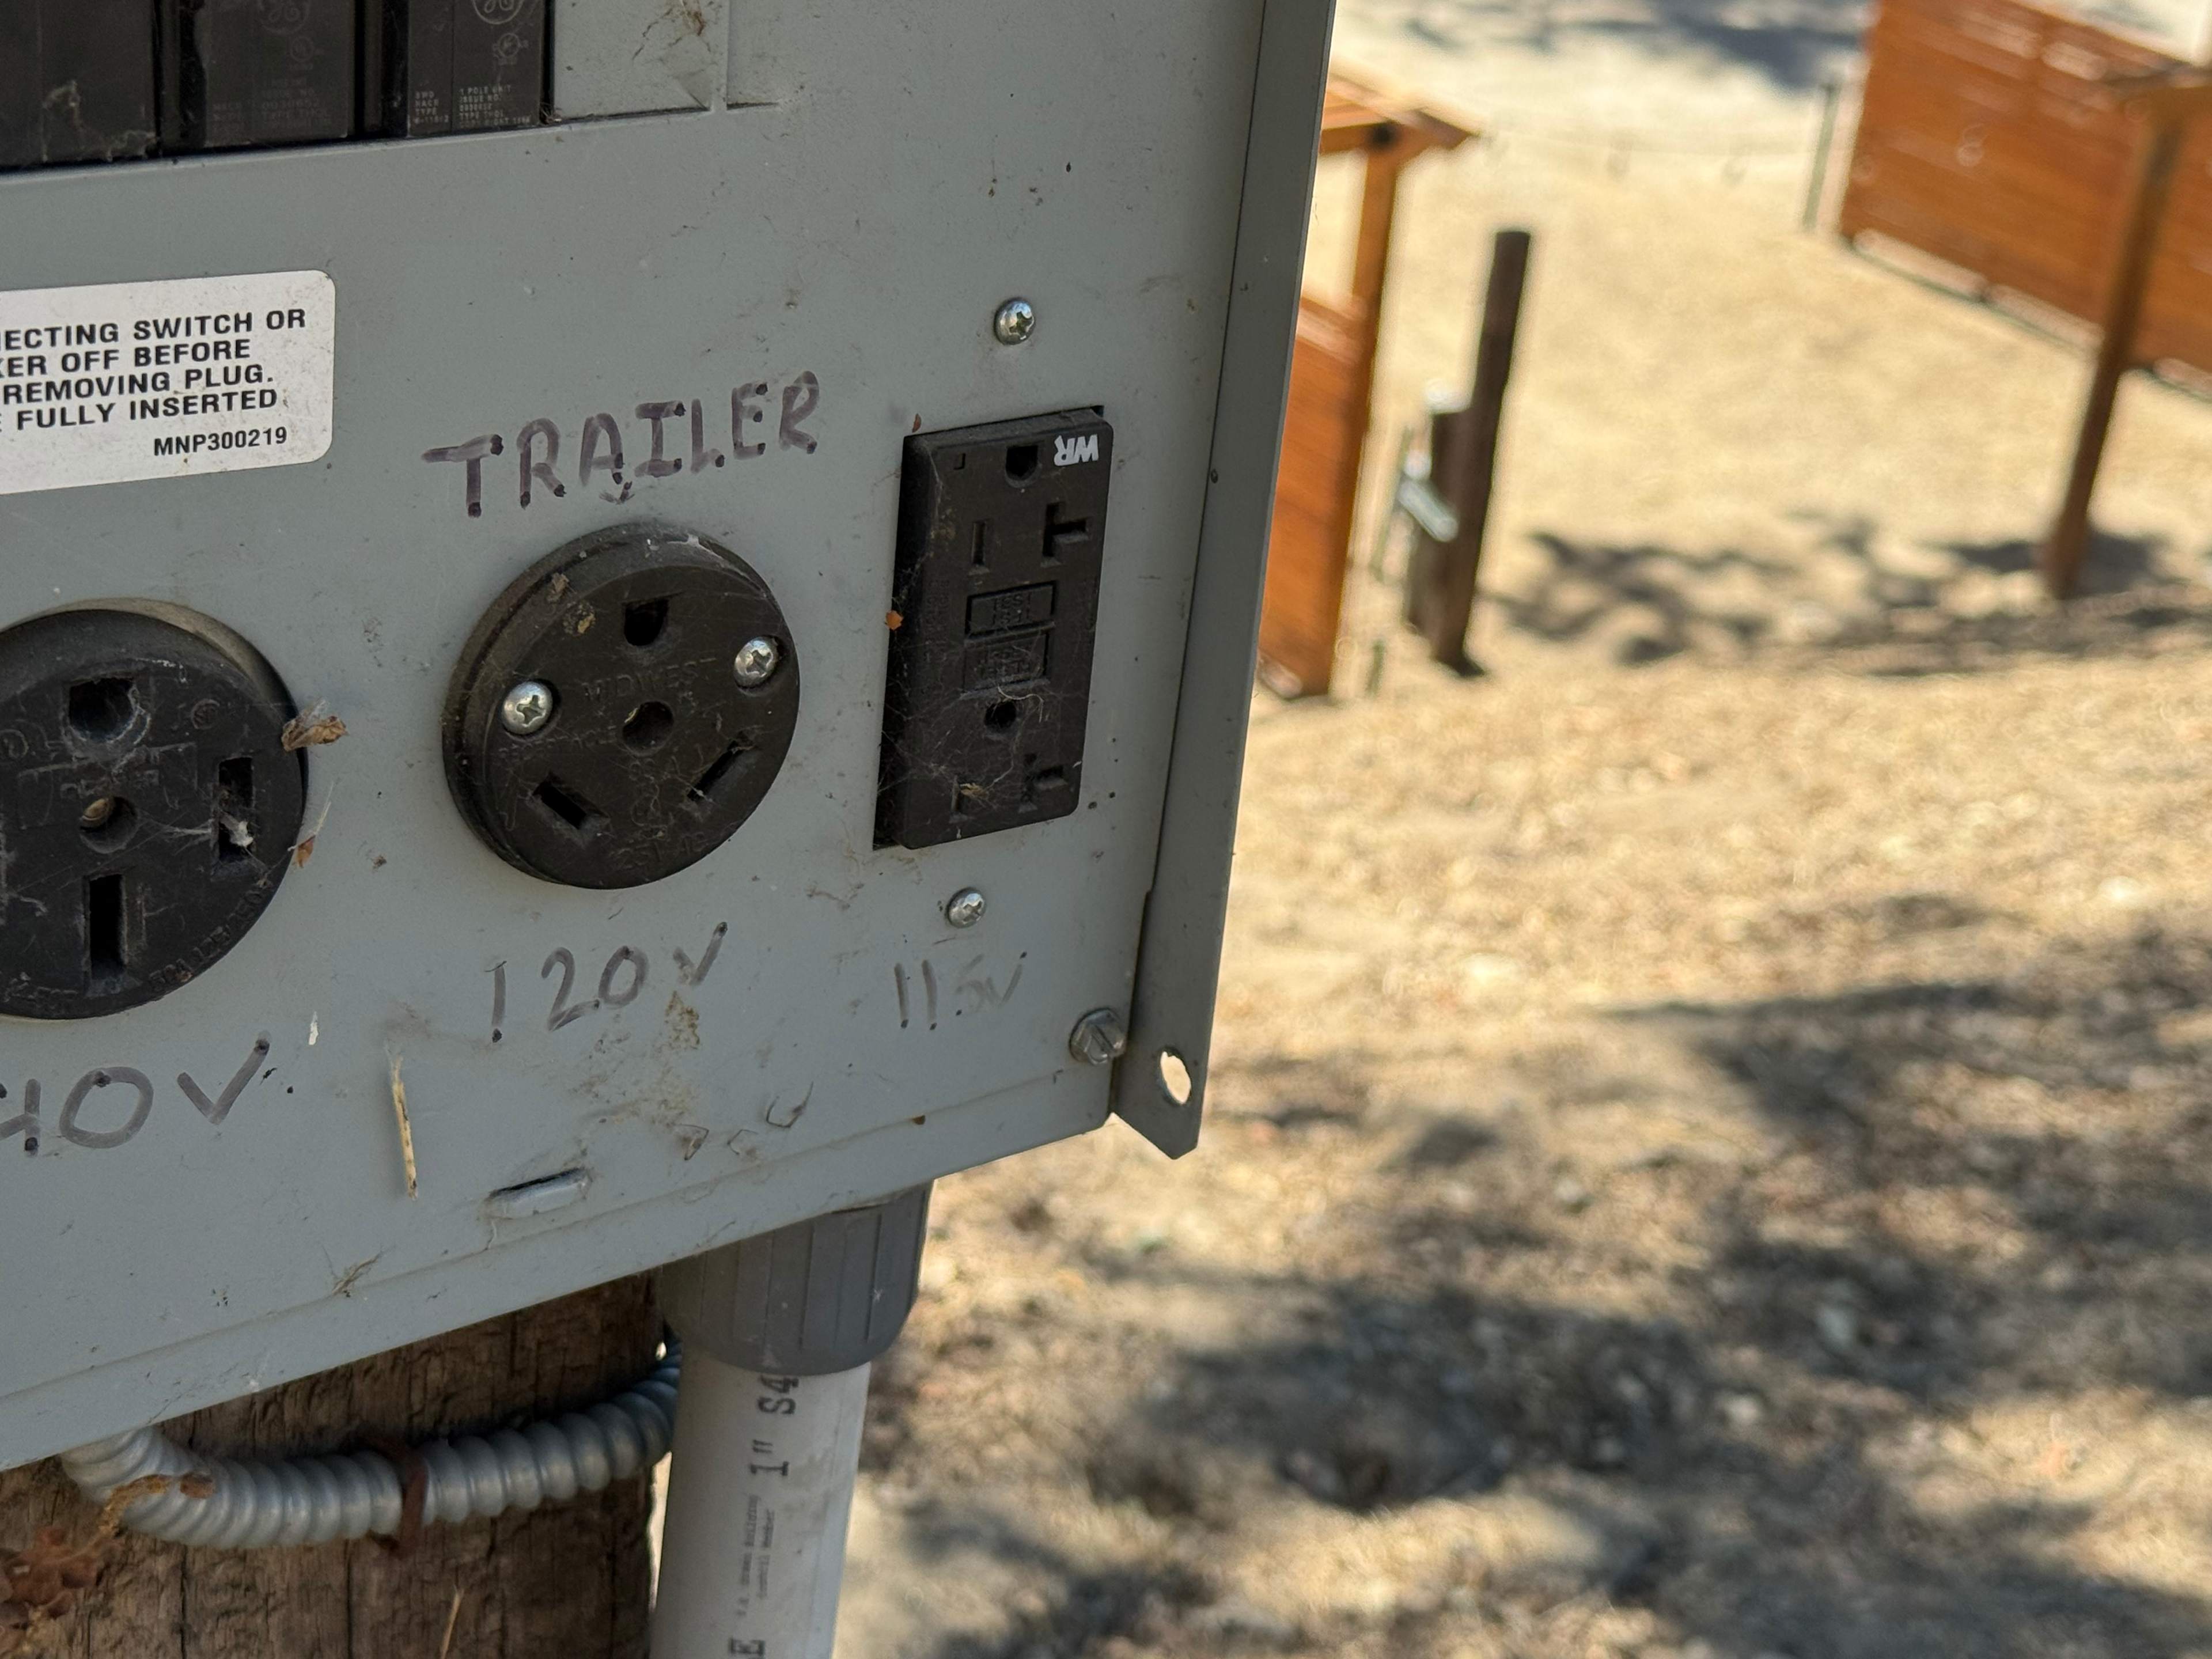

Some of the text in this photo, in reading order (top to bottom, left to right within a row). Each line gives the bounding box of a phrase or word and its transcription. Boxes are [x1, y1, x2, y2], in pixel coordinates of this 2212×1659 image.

[0, 309, 306, 351] ECTING SWITCH OR
[61, 350, 119, 373] OFF
[134, 339, 250, 368] BEFORE
[4, 363, 274, 404] REMOVING PLUG.
[17, 403, 116, 430] FULLY
[130, 389, 278, 421] INSERTED
[154, 426, 287, 456] MNP300219
[421, 370, 820, 518] TRAILER
[1054, 434, 1099, 467] WR
[492, 922, 728, 1043] 120V
